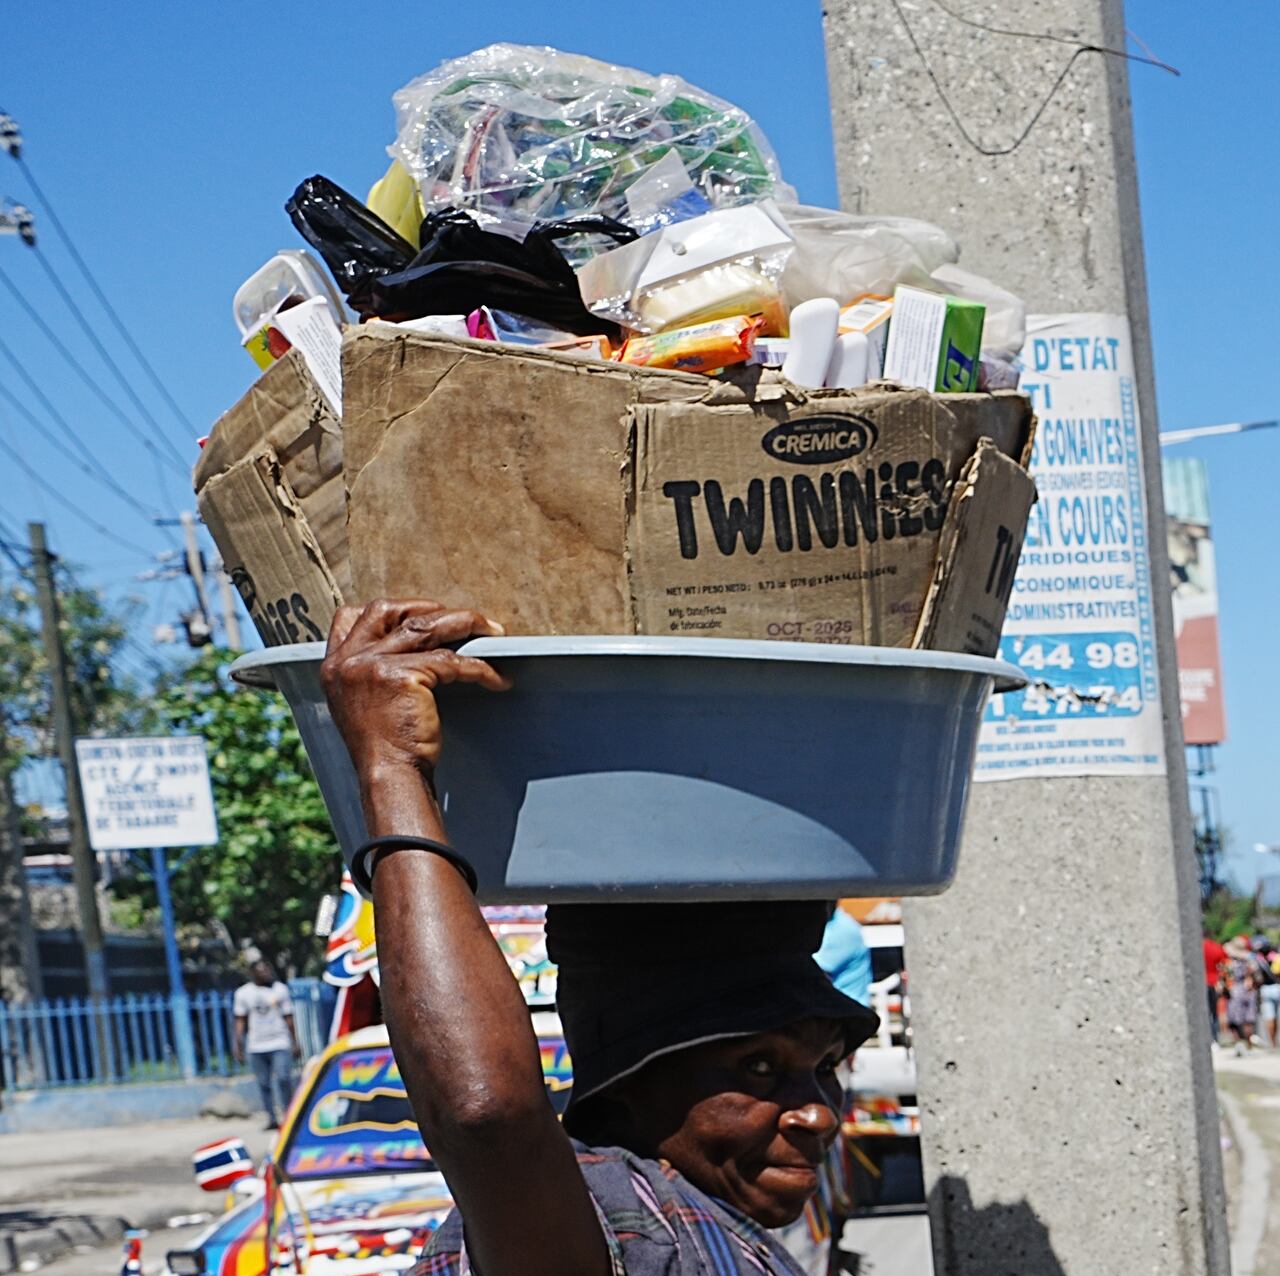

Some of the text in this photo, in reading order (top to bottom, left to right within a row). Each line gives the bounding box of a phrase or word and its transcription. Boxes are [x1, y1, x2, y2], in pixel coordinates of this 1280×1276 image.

[772, 430, 861, 456] CREMICA
[1044, 419, 1123, 465] GONAIVES
[1058, 496, 1128, 546] COURS
[1018, 551, 1132, 565] URIDIQUES
[1006, 600, 1136, 620] ADMINISTRATIVES
[1085, 641, 1139, 669] 98
